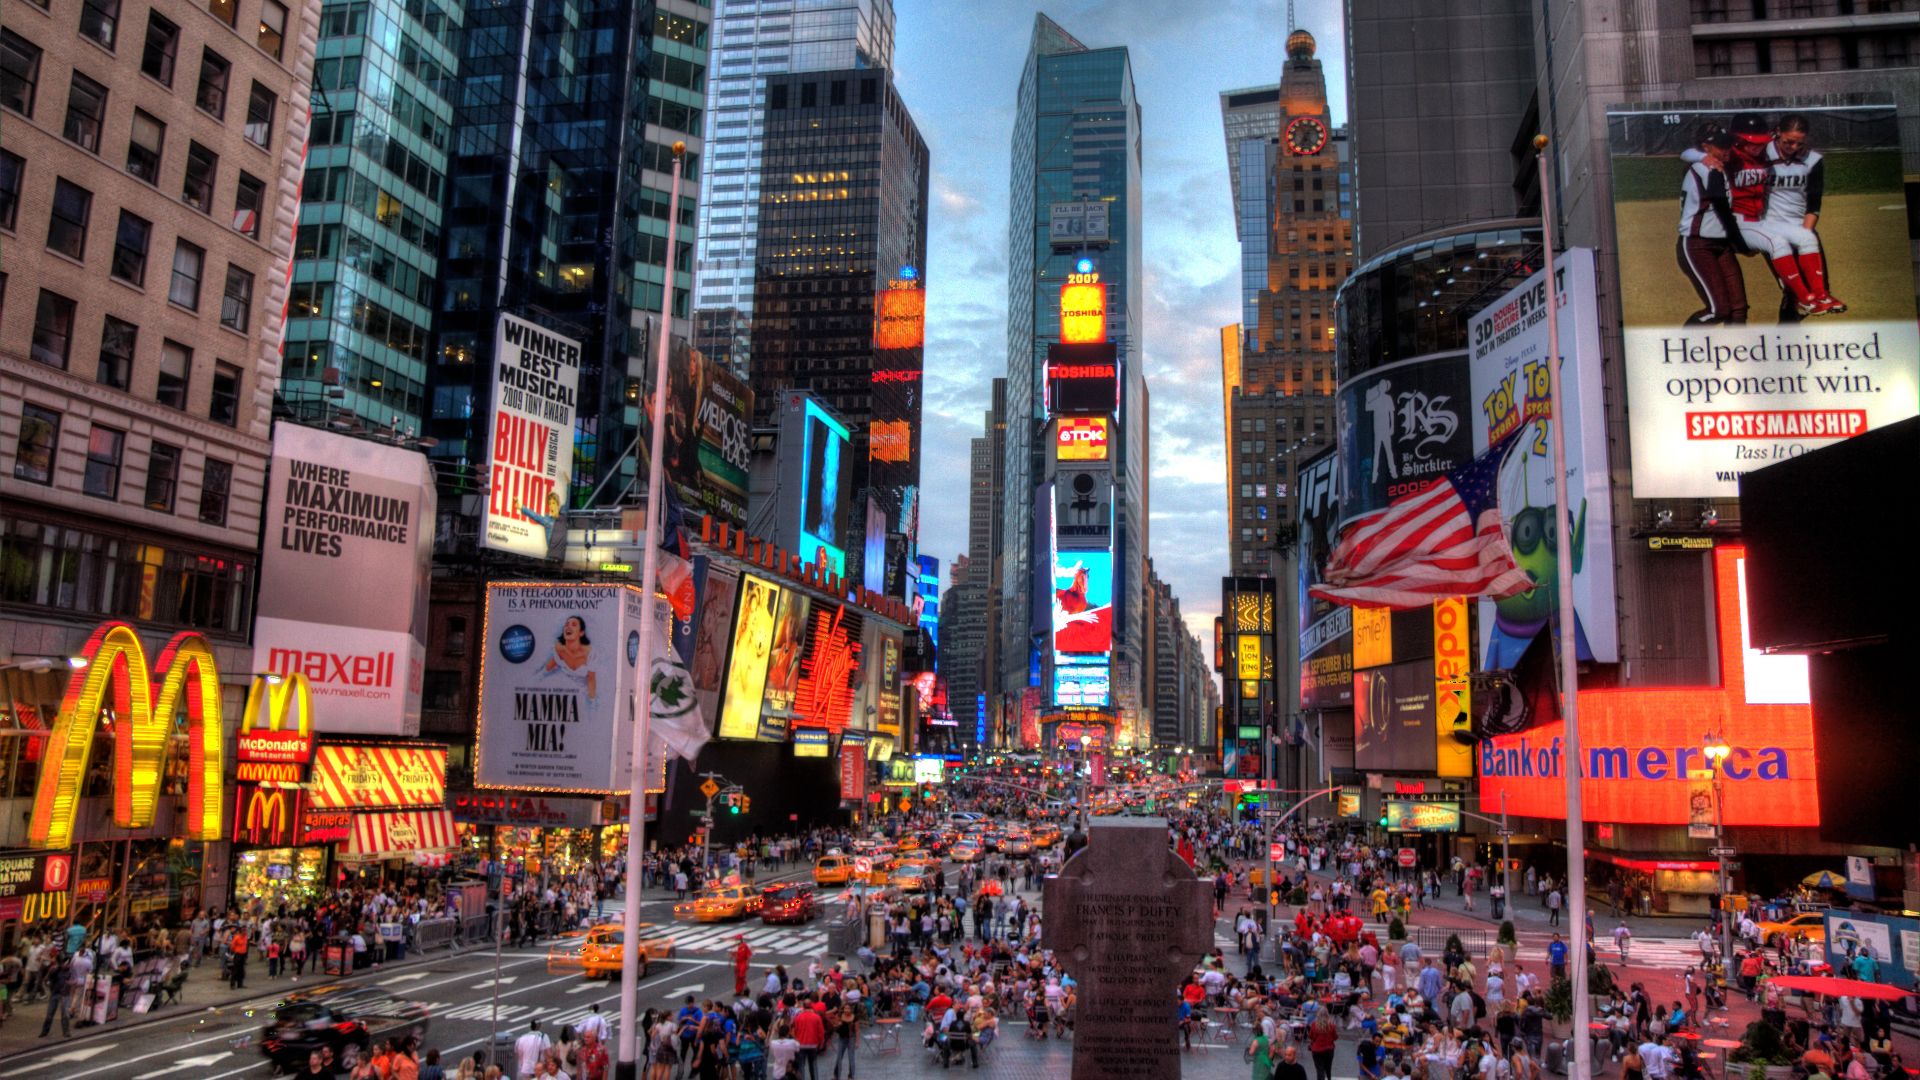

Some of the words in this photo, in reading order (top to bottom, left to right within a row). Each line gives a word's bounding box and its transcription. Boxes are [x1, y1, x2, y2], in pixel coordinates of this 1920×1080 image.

[1663, 114, 1681, 125] 215
[1734, 168, 1765, 188] WEST
[1067, 273, 1099, 284] 2009
[1063, 309, 1104, 317] TOSHIBA
[1475, 317, 1493, 346] 3D
[1493, 297, 1520, 323] DOUBLE
[1494, 310, 1520, 336] FEATURE
[504, 318, 580, 369] WINNER
[1475, 344, 1489, 361] ONLY
[1489, 340, 1496, 351] IN
[1496, 323, 1520, 348] THEATRES
[1522, 319, 1527, 332] 2
[1661, 334, 1769, 371] Helped
[1776, 331, 1883, 369] injured
[520, 348, 562, 381] BEST
[1050, 365, 1116, 379] TOSHIBA
[499, 363, 576, 408] MUSICAL
[1666, 374, 1808, 403] opponent
[1814, 366, 1882, 394] win.
[502, 385, 524, 412] 2009
[524, 391, 543, 419] TONY
[544, 401, 569, 426] AWARD
[1483, 368, 1518, 430] TOY
[1526, 401, 1553, 418] STOR
[697, 396, 748, 446] MELROSE
[1490, 411, 1519, 445] STORY
[1691, 412, 1862, 437] SPORTSMANSHIP
[494, 410, 550, 474] BILLY
[549, 428, 560, 457] MUSICAL
[1069, 429, 1105, 442] TDK
[1533, 415, 1548, 457] 2
[721, 434, 750, 473] PLACE
[1735, 444, 1768, 460] Pass
[1772, 443, 1784, 460] It
[290, 459, 350, 488] WHERE
[1401, 458, 1453, 478] Sheckler
[489, 463, 556, 526] ELLIOT
[1387, 480, 1430, 497] 2009
[286, 479, 410, 526] MAXIMUM
[284, 506, 407, 545] PERFORMANCE
[1058, 525, 1110, 536] CHEVROLET
[281, 526, 343, 559] LIVES
[508, 599, 519, 609] IS
[519, 599, 526, 609] A
[520, 587, 573, 598] FEEL-GOOD
[576, 587, 618, 599] MUSICAL
[1357, 615, 1387, 646] smile?
[1241, 651, 1258, 662] LION
[1243, 643, 1256, 651] THE
[267, 647, 395, 688] maxell
[1241, 663, 1259, 673] KING
[1310, 653, 1342, 674] SEPTEMBER
[1343, 652, 1352, 670] 19
[513, 692, 580, 723] MAMMA
[238, 738, 308, 752] McDonald's
[526, 722, 566, 752] MIA!
[249, 751, 296, 760] Restaurant
[1481, 737, 1534, 778] Bank
[1536, 736, 1561, 778] of
[456, 795, 550, 811] DIGITAL
[1387, 793, 1460, 801] MARQUIS
[0, 857, 35, 873] SQUARE
[1075, 904, 1125, 916] FRANCIS
[1139, 905, 1183, 918] DUFFY
